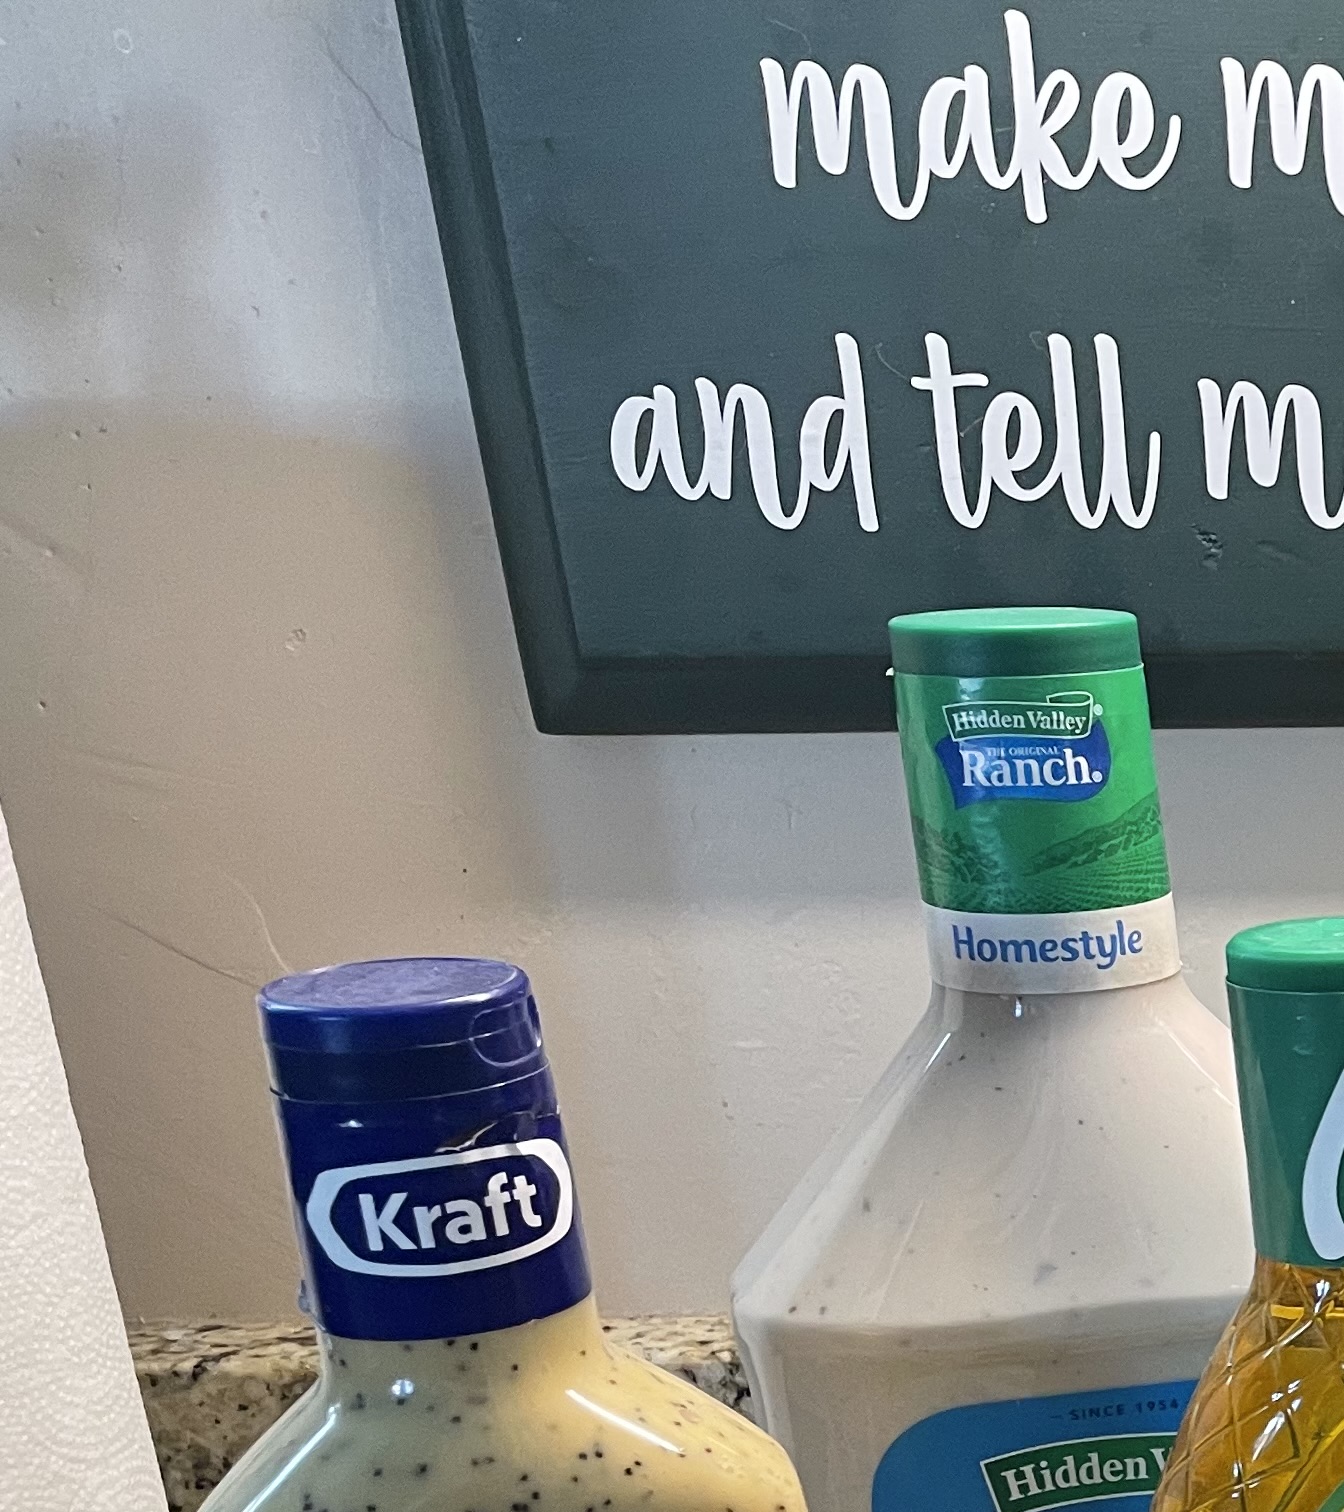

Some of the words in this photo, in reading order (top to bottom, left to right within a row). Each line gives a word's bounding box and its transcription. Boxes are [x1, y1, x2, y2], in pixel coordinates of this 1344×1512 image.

[759, 9, 1181, 224] make
[609, 334, 880, 534] and
[911, 330, 1162, 531] tell
[952, 709, 1026, 732] Hidden
[1027, 710, 1086, 734] Valley
[1009, 745, 1061, 757] ORIGINAL
[951, 919, 1144, 970] Homestyle
[358, 1171, 543, 1252] Kraft
[1068, 1401, 1126, 1421] SINCE
[1135, 1398, 1179, 1416] 1954
[1000, 1451, 1149, 1502] Hidden
